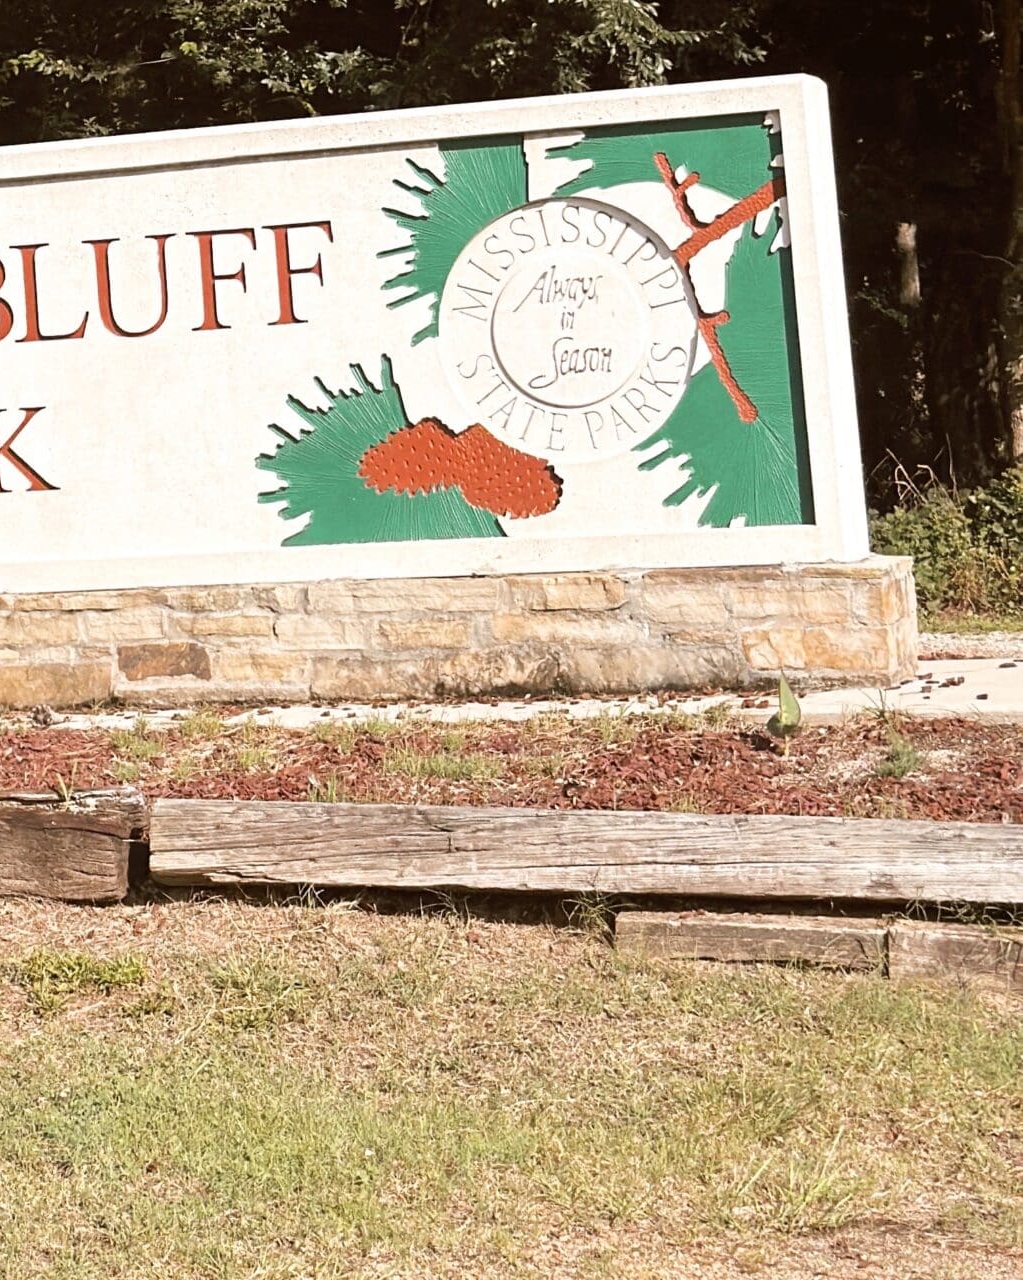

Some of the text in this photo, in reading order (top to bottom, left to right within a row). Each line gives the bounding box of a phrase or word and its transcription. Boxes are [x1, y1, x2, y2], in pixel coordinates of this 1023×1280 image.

[452, 205, 687, 322] MISSISSIPPI
[513, 265, 604, 313] Always
[560, 306, 575, 331] in
[528, 337, 612, 390] Season
[457, 341, 688, 452] STATE PARKS
